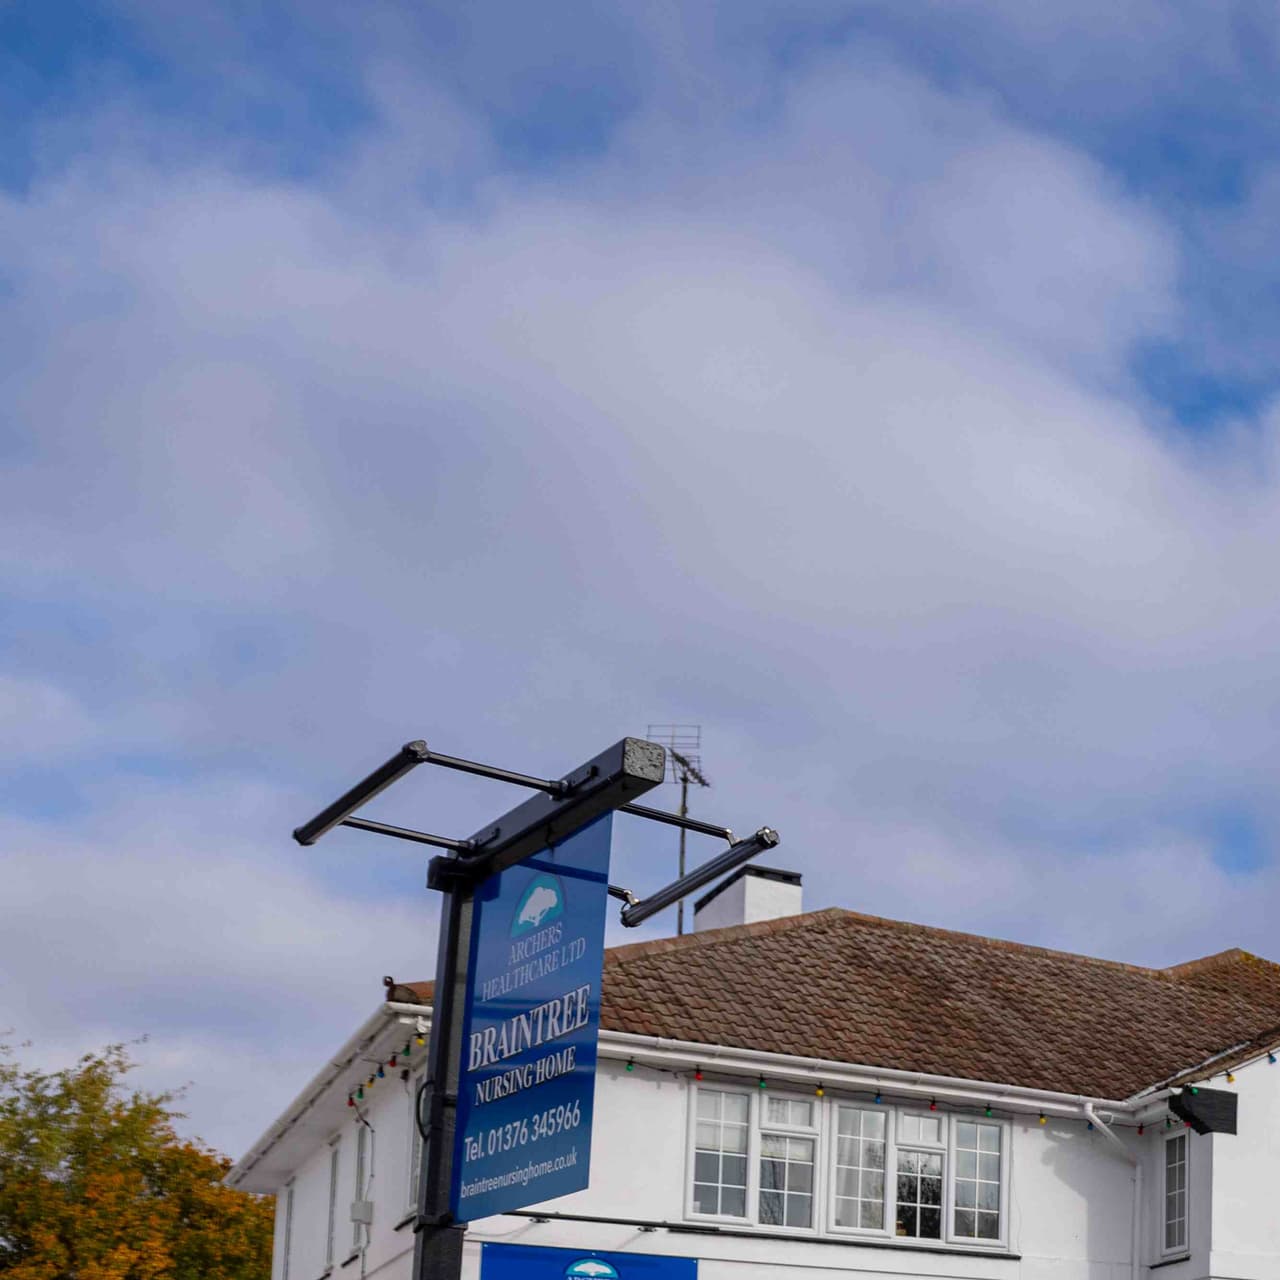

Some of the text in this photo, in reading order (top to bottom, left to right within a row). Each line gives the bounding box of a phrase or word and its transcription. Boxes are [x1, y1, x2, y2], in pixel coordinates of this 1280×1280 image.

[482, 937, 586, 1002] HEALTHCARE LTD
[509, 922, 562, 965] ARCHERS
[467, 984, 590, 1072] BRAINTREE
[474, 1045, 577, 1106] NURSING HOME
[464, 1099, 581, 1163] Tel. 01376 345966
[460, 1146, 578, 1199] braintreenursinghome.co.uk
